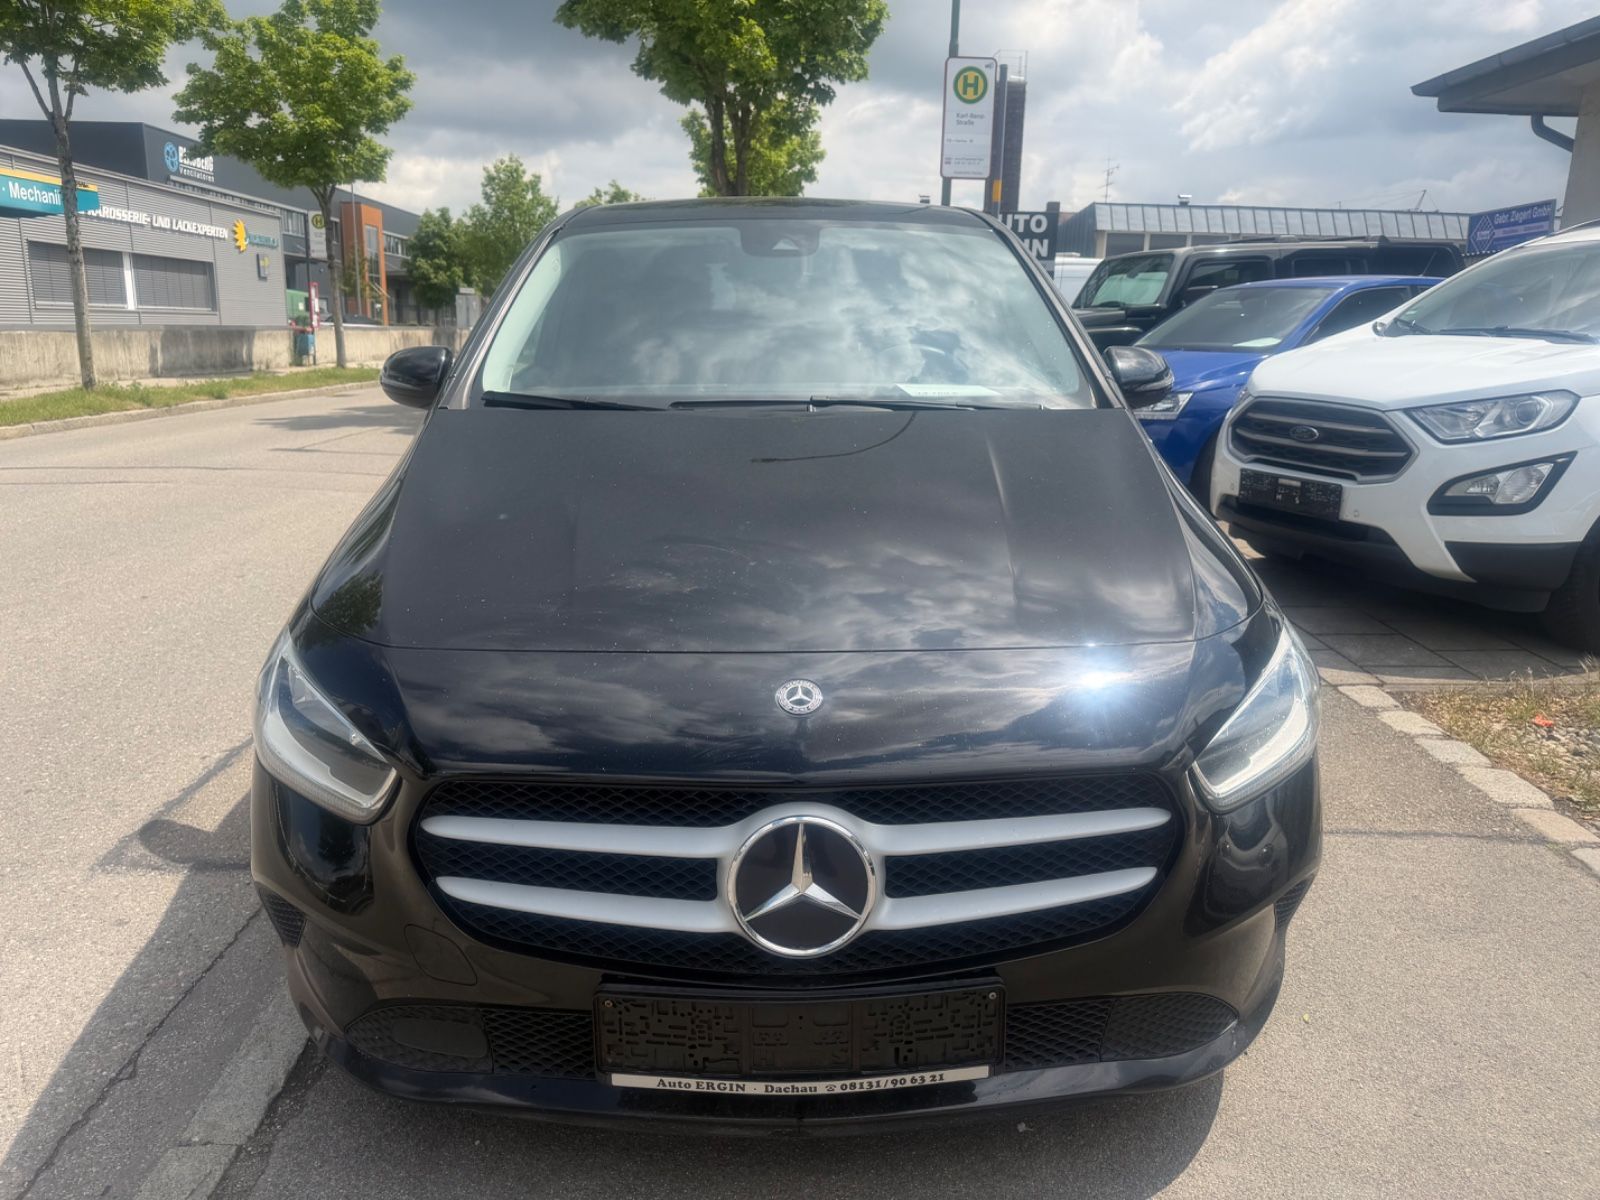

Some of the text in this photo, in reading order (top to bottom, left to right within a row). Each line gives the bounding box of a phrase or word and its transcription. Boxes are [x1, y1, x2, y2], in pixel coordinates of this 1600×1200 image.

[962, 75, 979, 96] H
[152, 215, 171, 228] UND
[172, 218, 229, 239] LACKEXPERTEN
[997, 213, 1048, 233] UTO
[656, 1078, 692, 1089] Auto
[695, 1080, 746, 1092] ERGIN
[763, 1083, 818, 1094] Dachau
[910, 1074, 926, 1084] 63
[929, 1073, 945, 1082] 21
